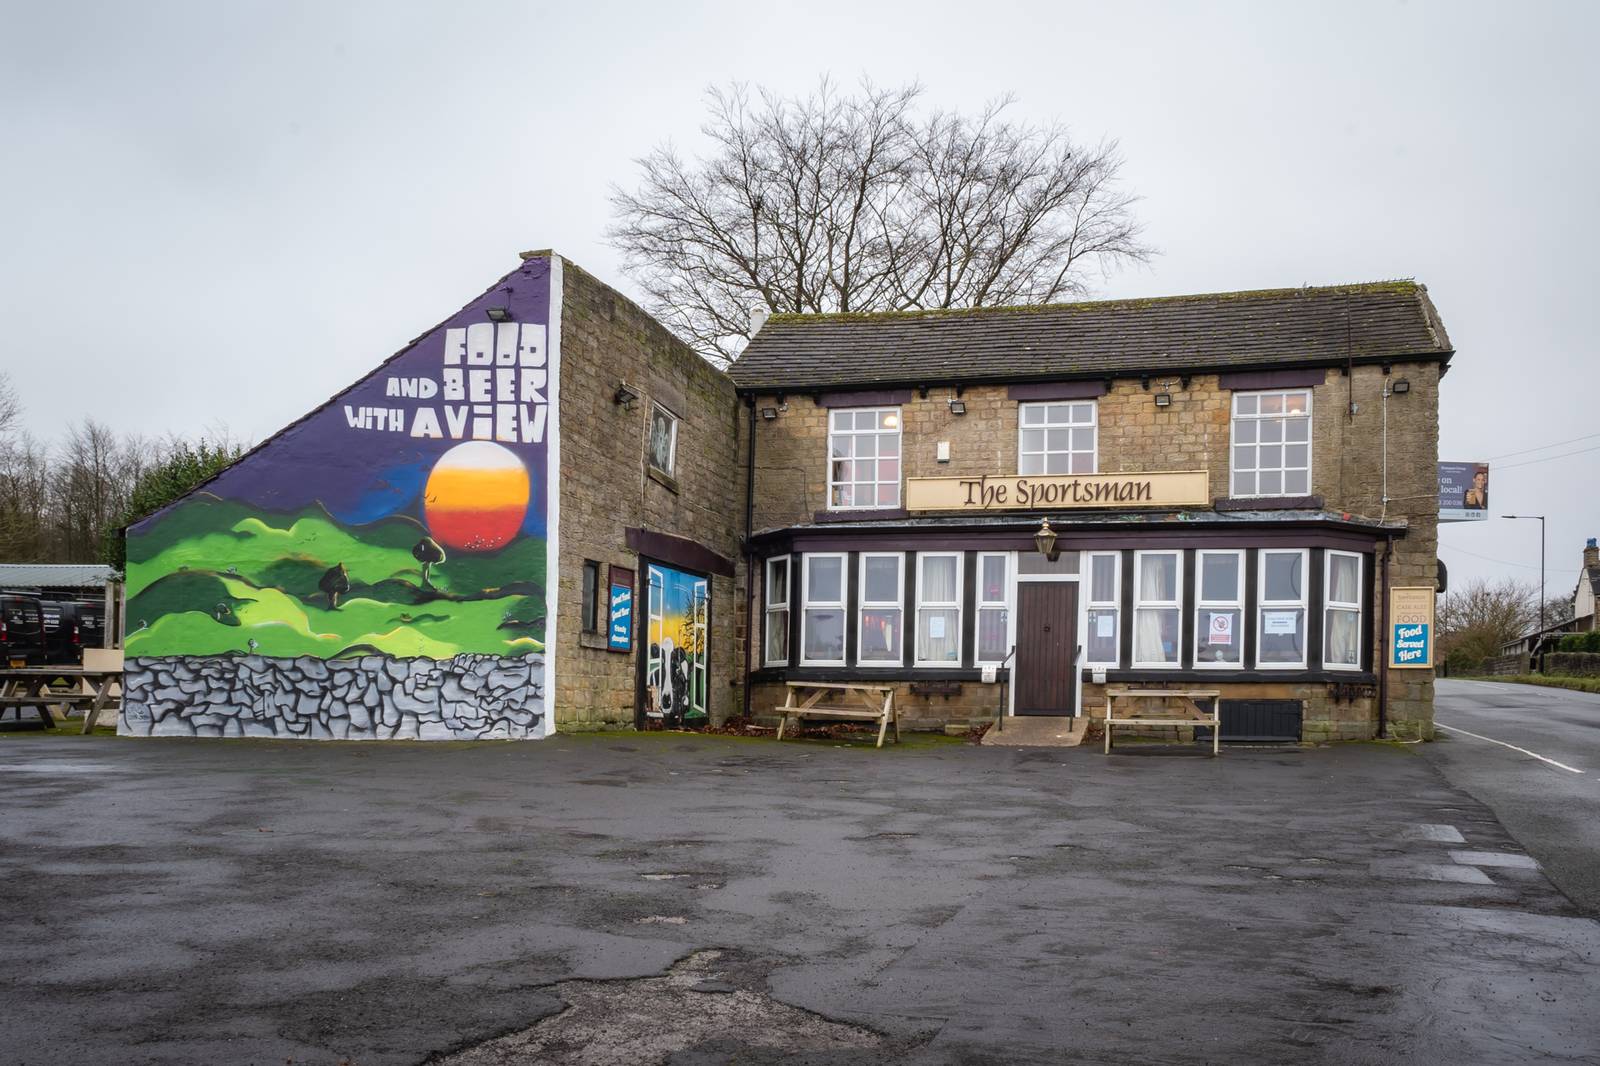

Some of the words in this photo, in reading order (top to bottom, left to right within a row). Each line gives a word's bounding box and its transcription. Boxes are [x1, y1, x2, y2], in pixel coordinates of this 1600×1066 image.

[444, 322, 547, 367] FOOD
[386, 377, 438, 399] AND
[443, 368, 547, 403] BEER
[410, 407, 443, 439] A
[960, 475, 1008, 510] The
[1016, 479, 1153, 510] Sportsman
[1397, 615, 1426, 623] FOOD
[1398, 624, 1423, 639] Food
[1397, 640, 1424, 648] Served
[1398, 649, 1422, 661] Here
